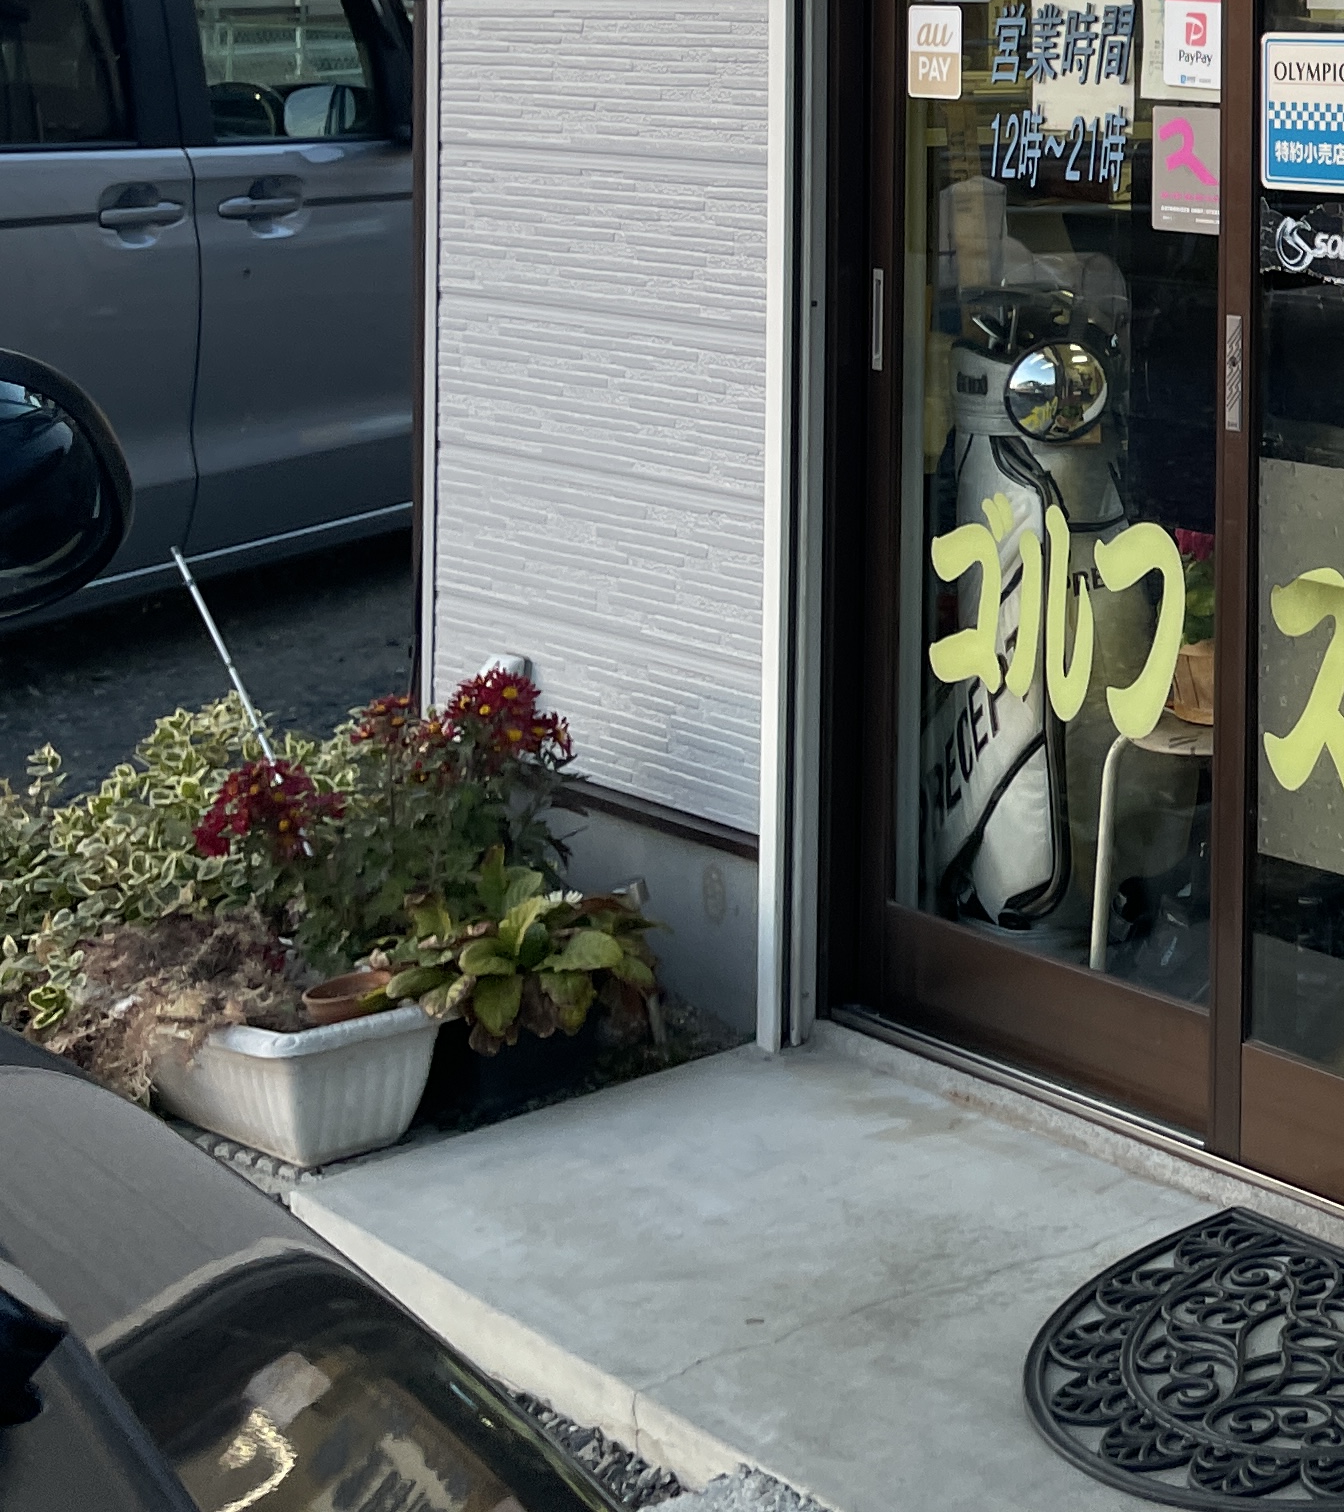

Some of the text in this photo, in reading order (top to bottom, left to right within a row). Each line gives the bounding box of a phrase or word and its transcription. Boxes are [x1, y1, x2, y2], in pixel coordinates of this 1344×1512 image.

[917, 22, 954, 47] au
[991, 2, 1135, 85] 営業時間
[918, 56, 951, 82] PAY
[1178, 49, 1213, 67] PayPay
[929, 492, 1186, 739] ゴルフ
